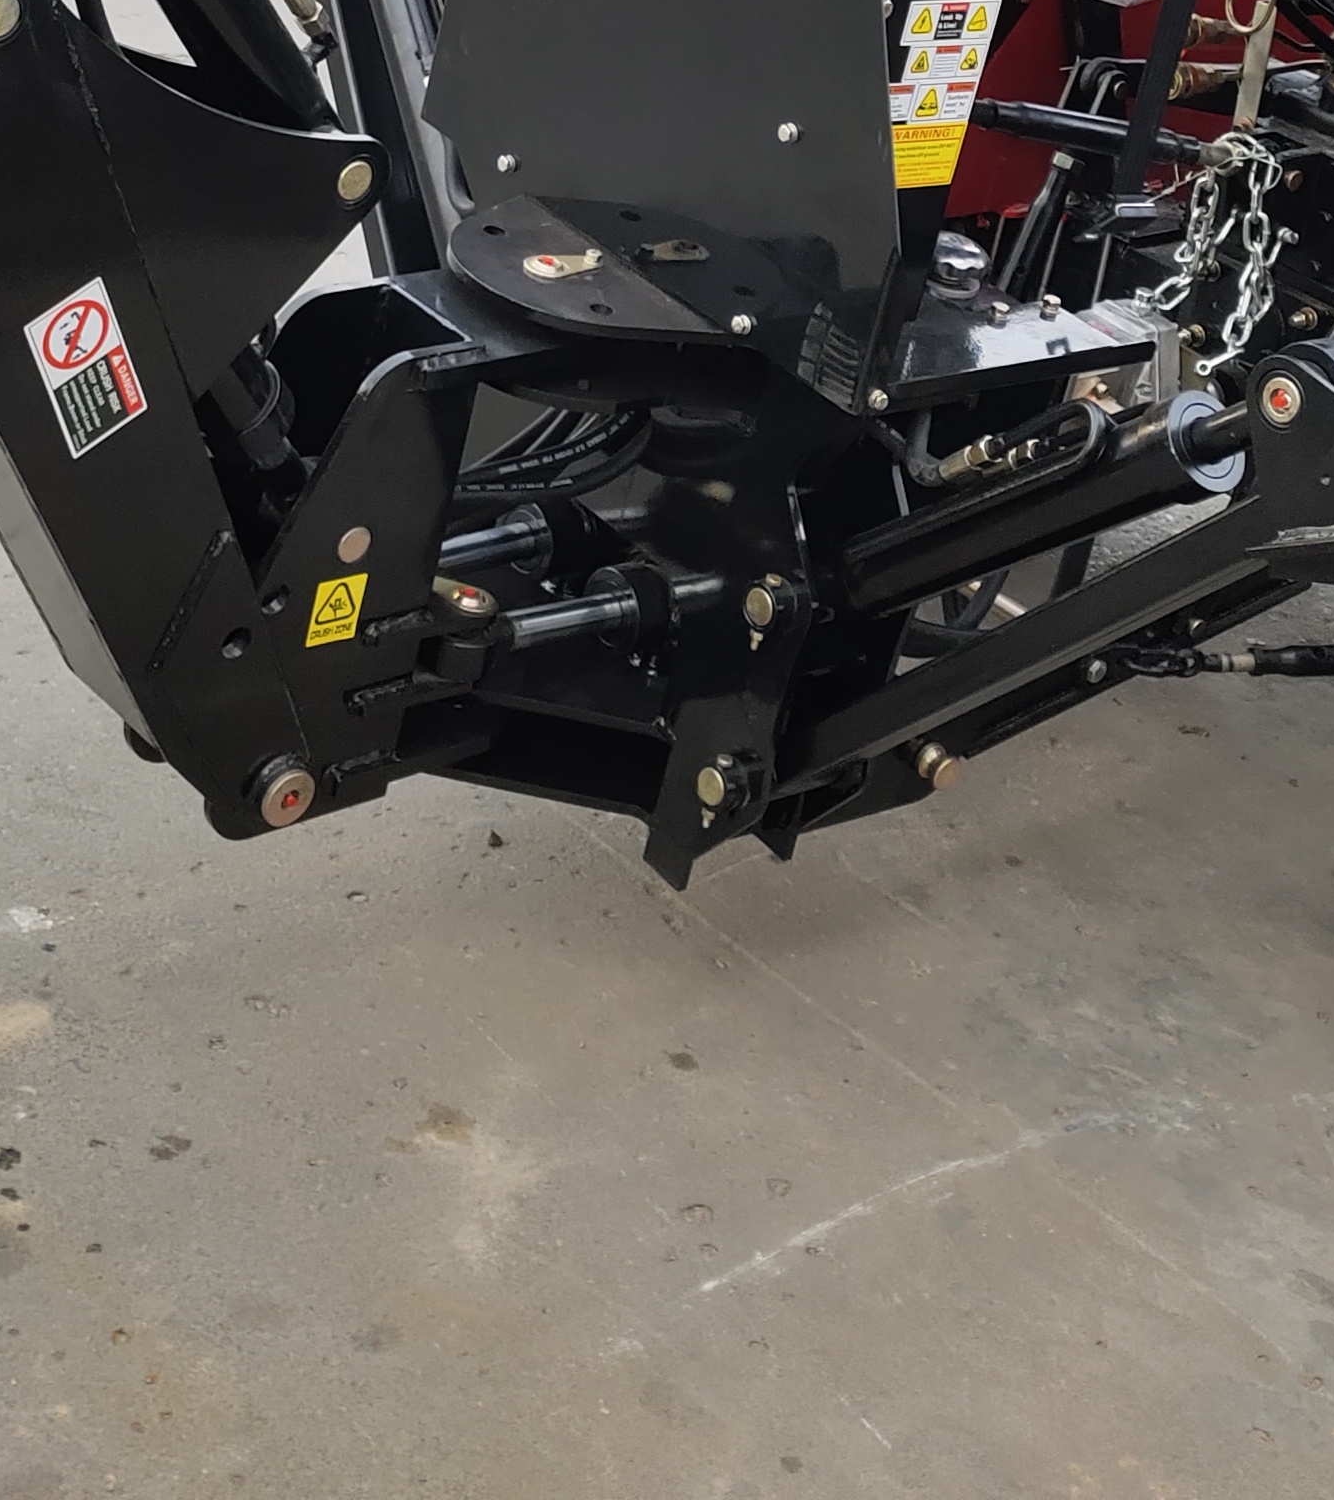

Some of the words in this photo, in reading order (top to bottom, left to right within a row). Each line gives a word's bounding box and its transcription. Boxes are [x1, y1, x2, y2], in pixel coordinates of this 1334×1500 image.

[96, 360, 114, 392] CRUSH
[108, 390, 123, 414] RISK
[118, 364, 139, 406] DANGER
